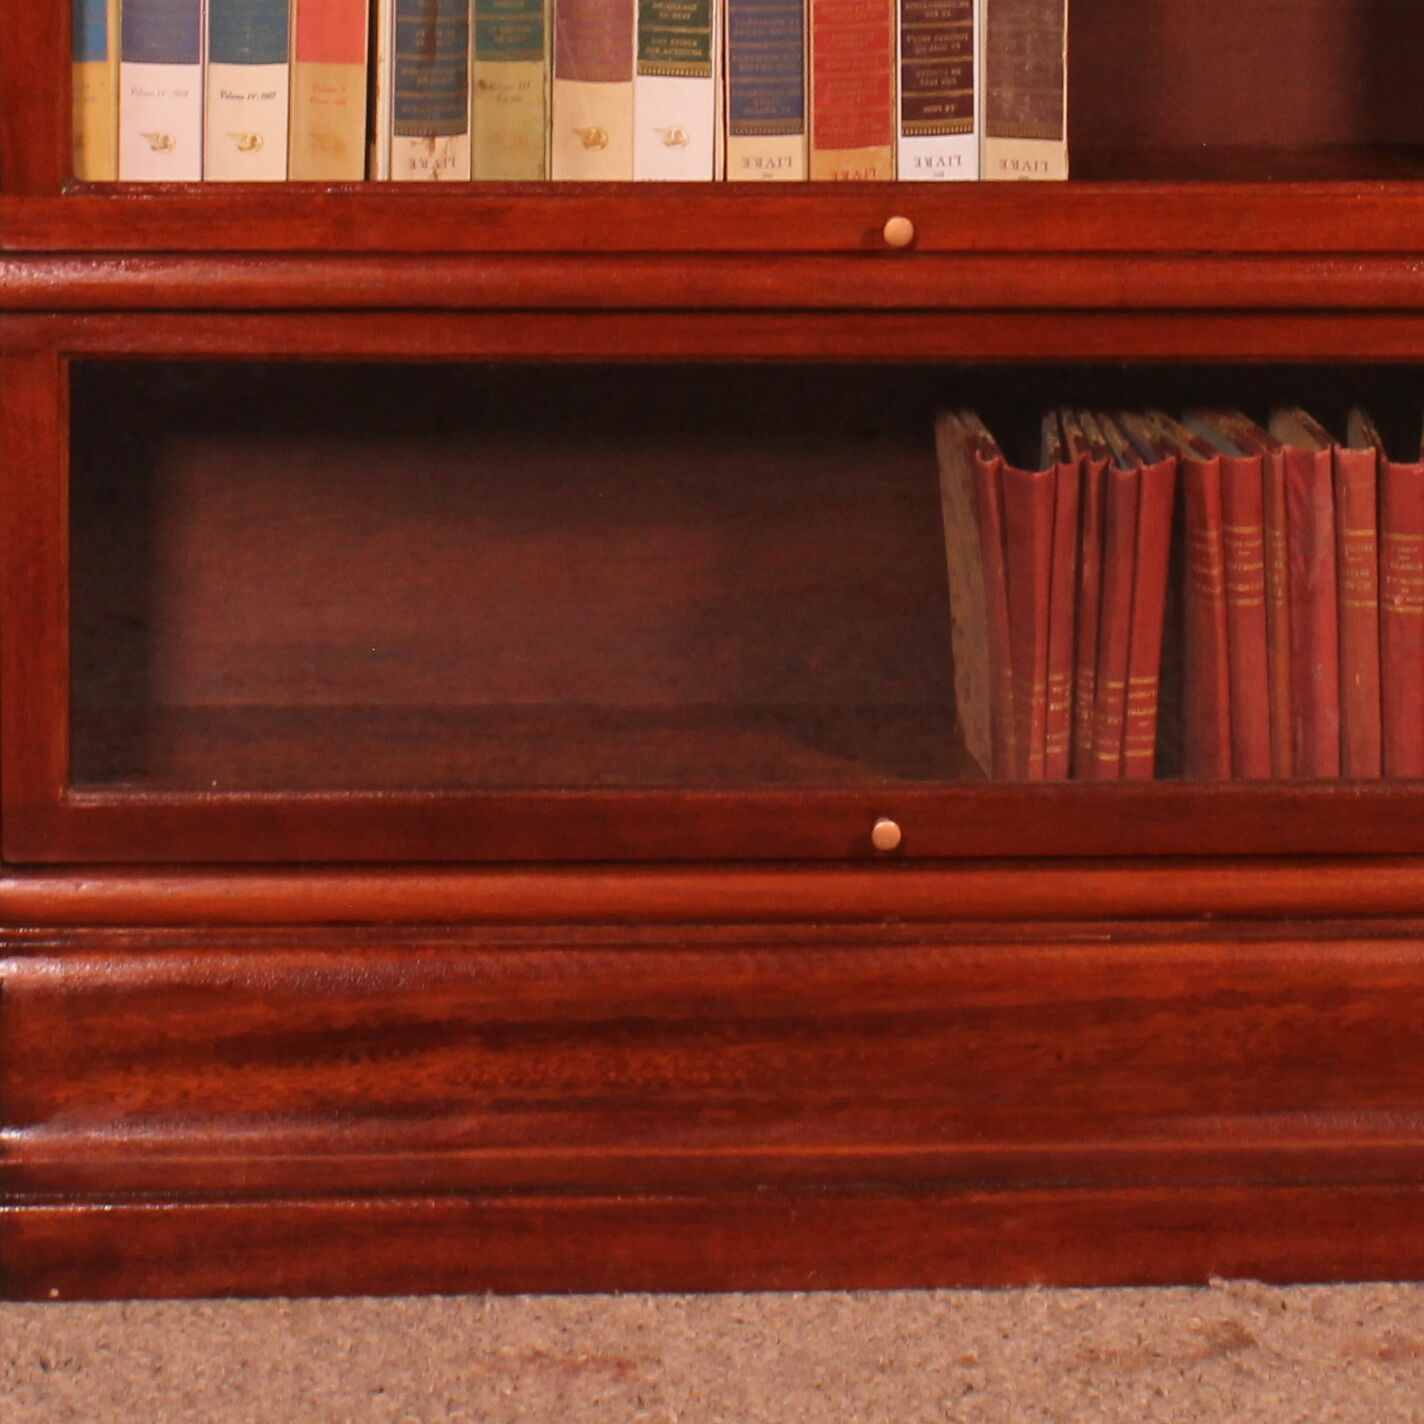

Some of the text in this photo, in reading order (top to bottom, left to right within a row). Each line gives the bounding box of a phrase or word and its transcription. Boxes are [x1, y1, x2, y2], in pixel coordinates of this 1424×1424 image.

[408, 157, 456, 170] LIVRE
[741, 156, 793, 168] LIVRE
[913, 154, 962, 167] LIVRE
[999, 159, 1049, 172] LIVRE
